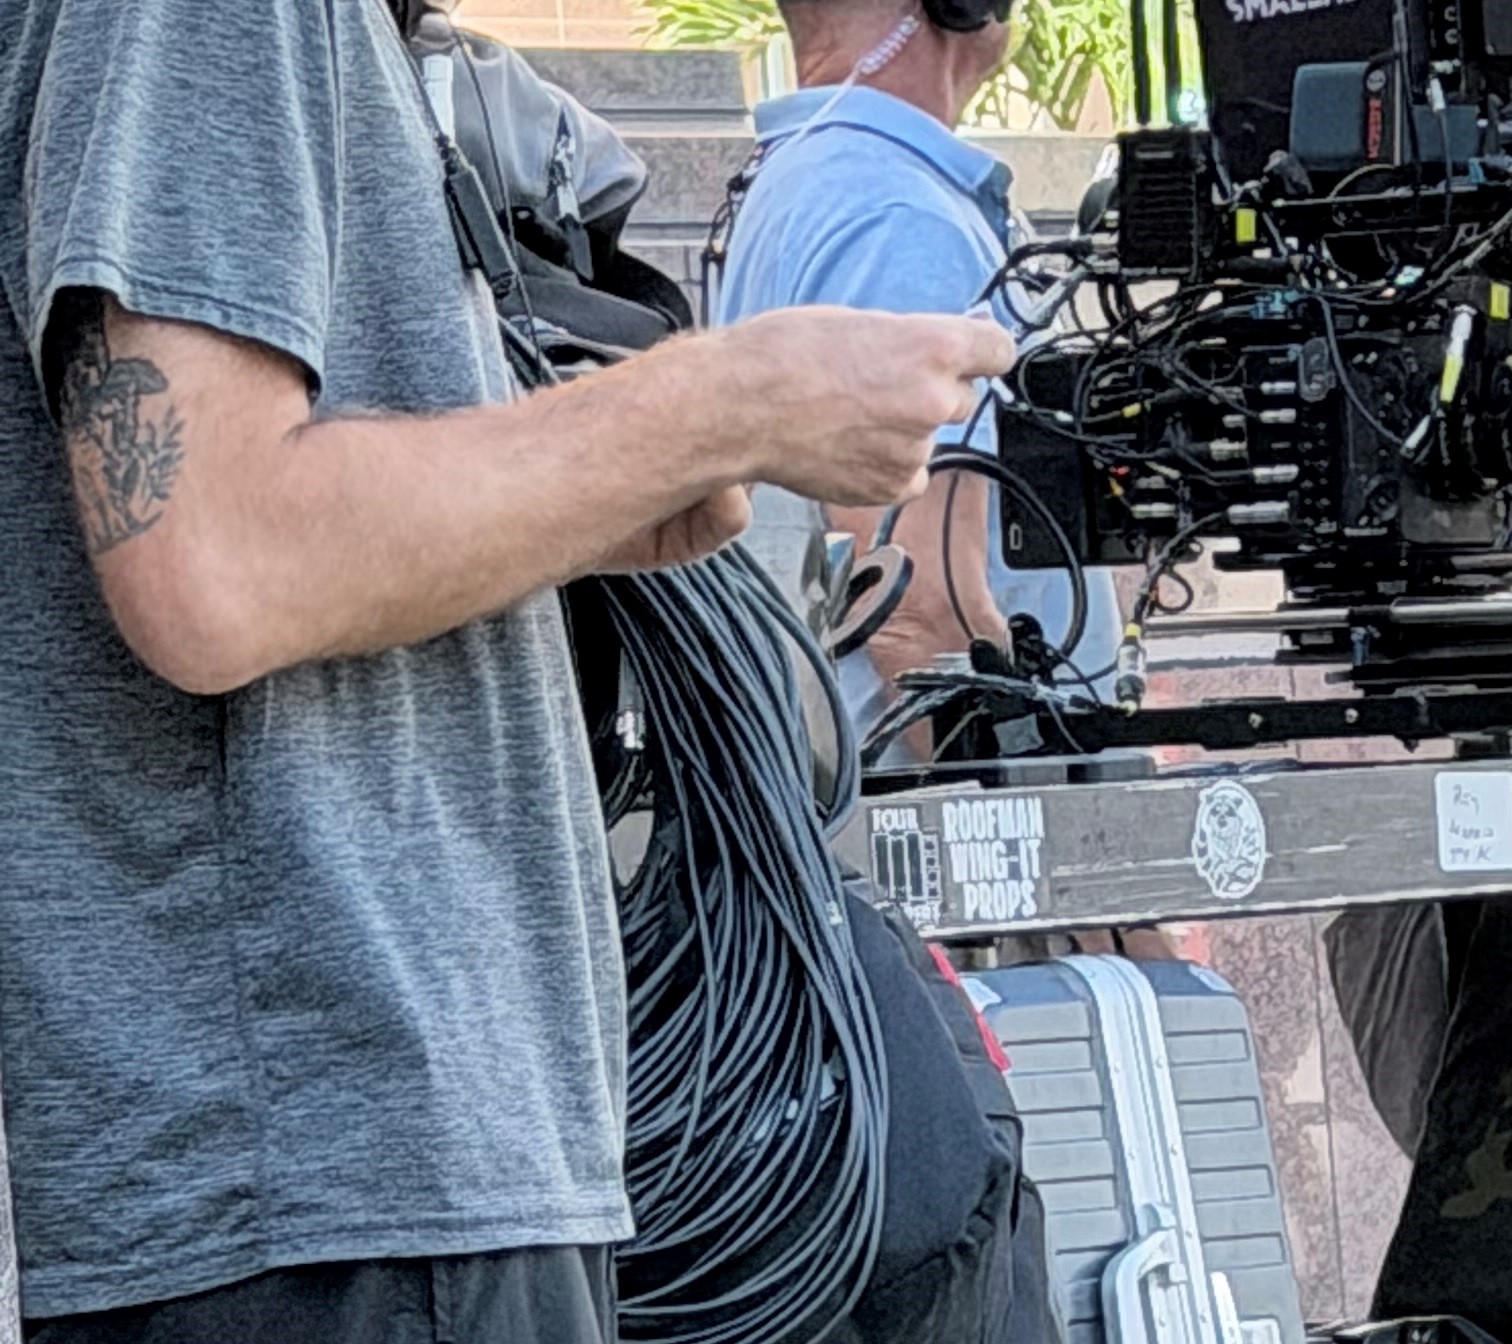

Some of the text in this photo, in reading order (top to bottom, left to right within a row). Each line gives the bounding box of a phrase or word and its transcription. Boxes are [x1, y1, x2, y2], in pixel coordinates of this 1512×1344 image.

[942, 796, 1045, 842] ROOFMAN
[951, 838, 1042, 882] WING-IT
[963, 879, 1039, 920] PROPS
